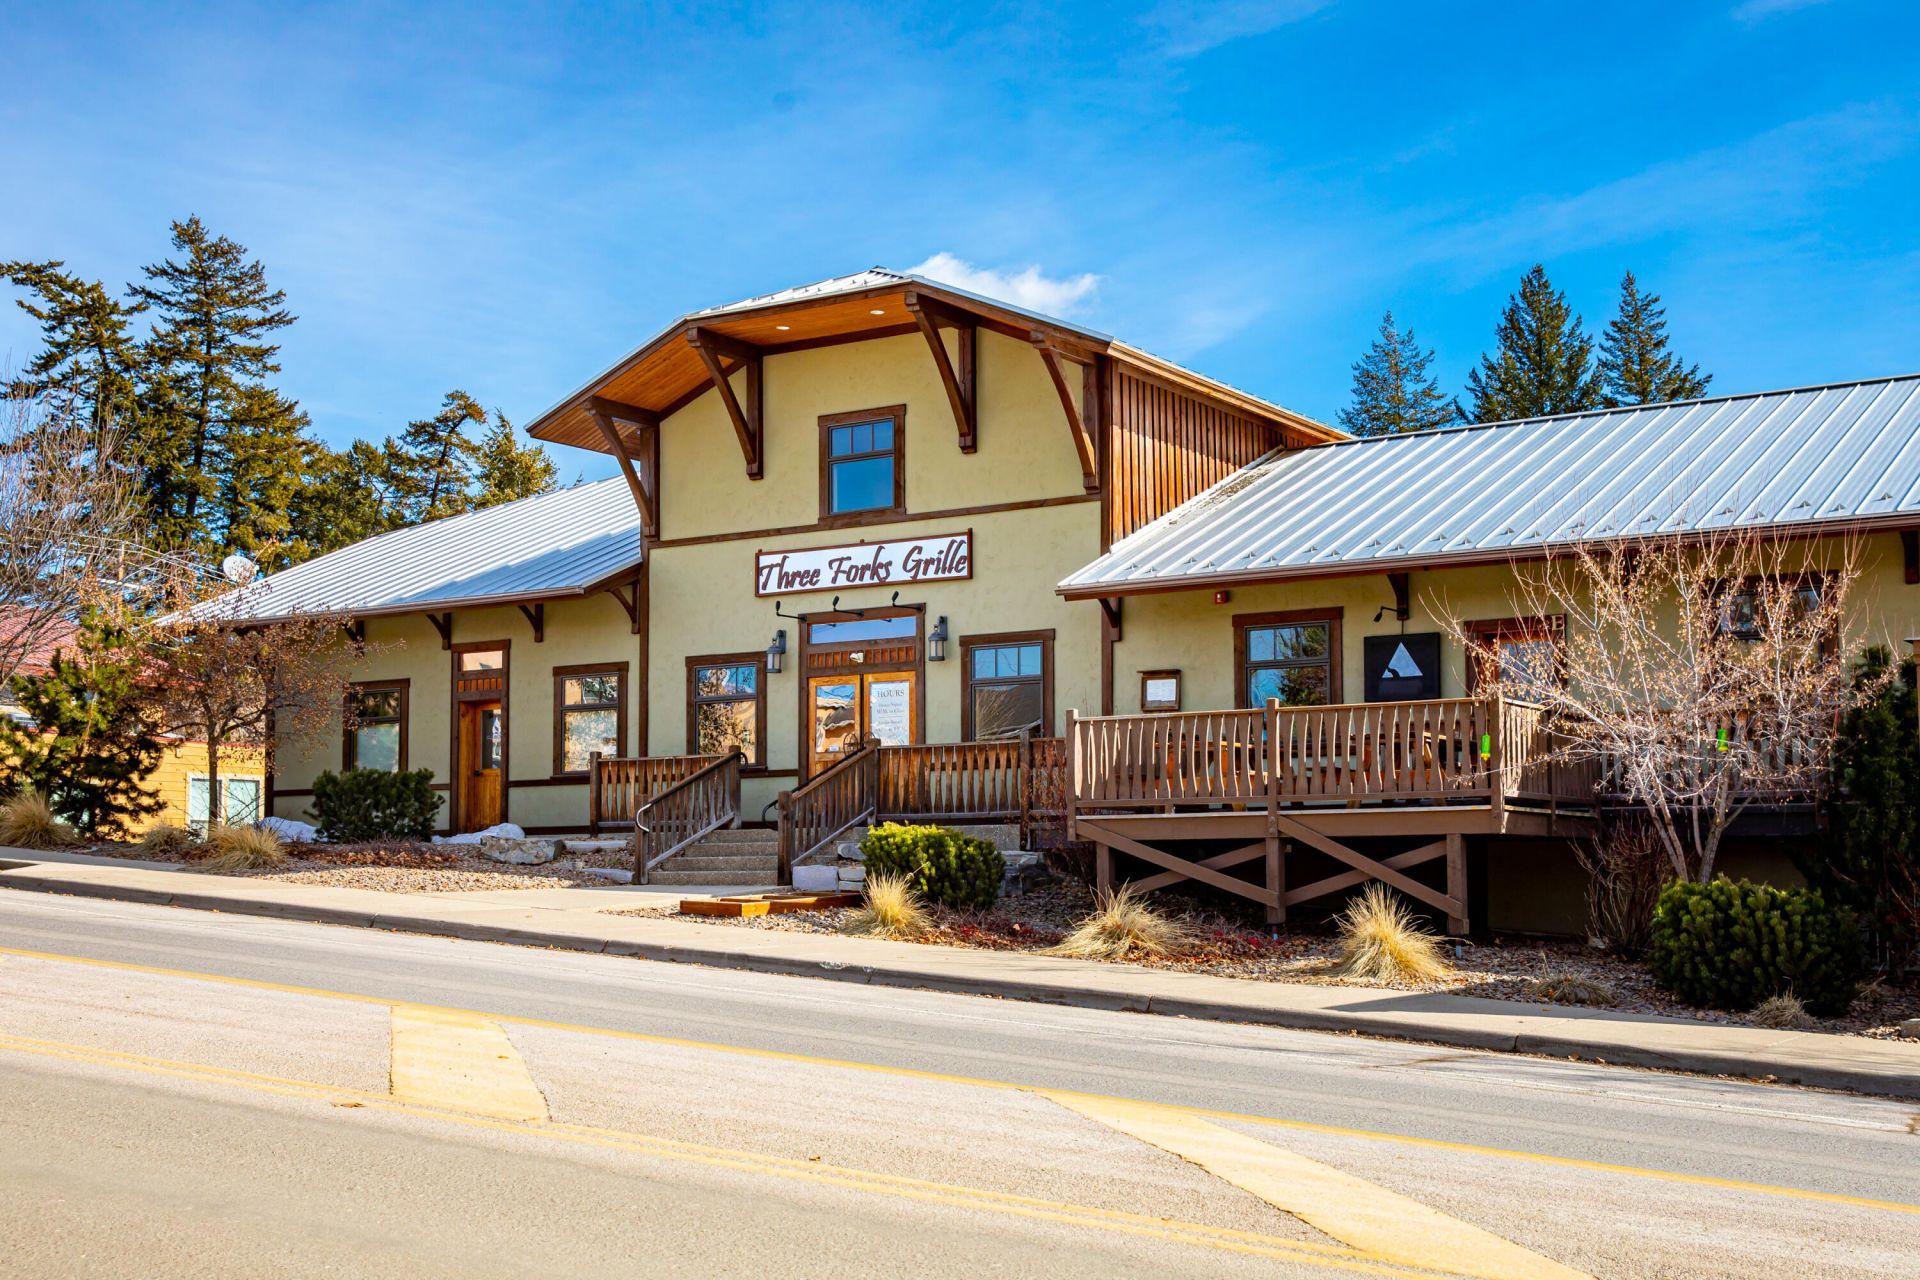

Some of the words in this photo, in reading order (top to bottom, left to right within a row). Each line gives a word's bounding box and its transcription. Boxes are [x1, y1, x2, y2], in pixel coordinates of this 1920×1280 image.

[759, 555, 821, 591] Three
[828, 545, 893, 583] Forks
[902, 538, 968, 580] Grille
[877, 689, 905, 698] HOURS
